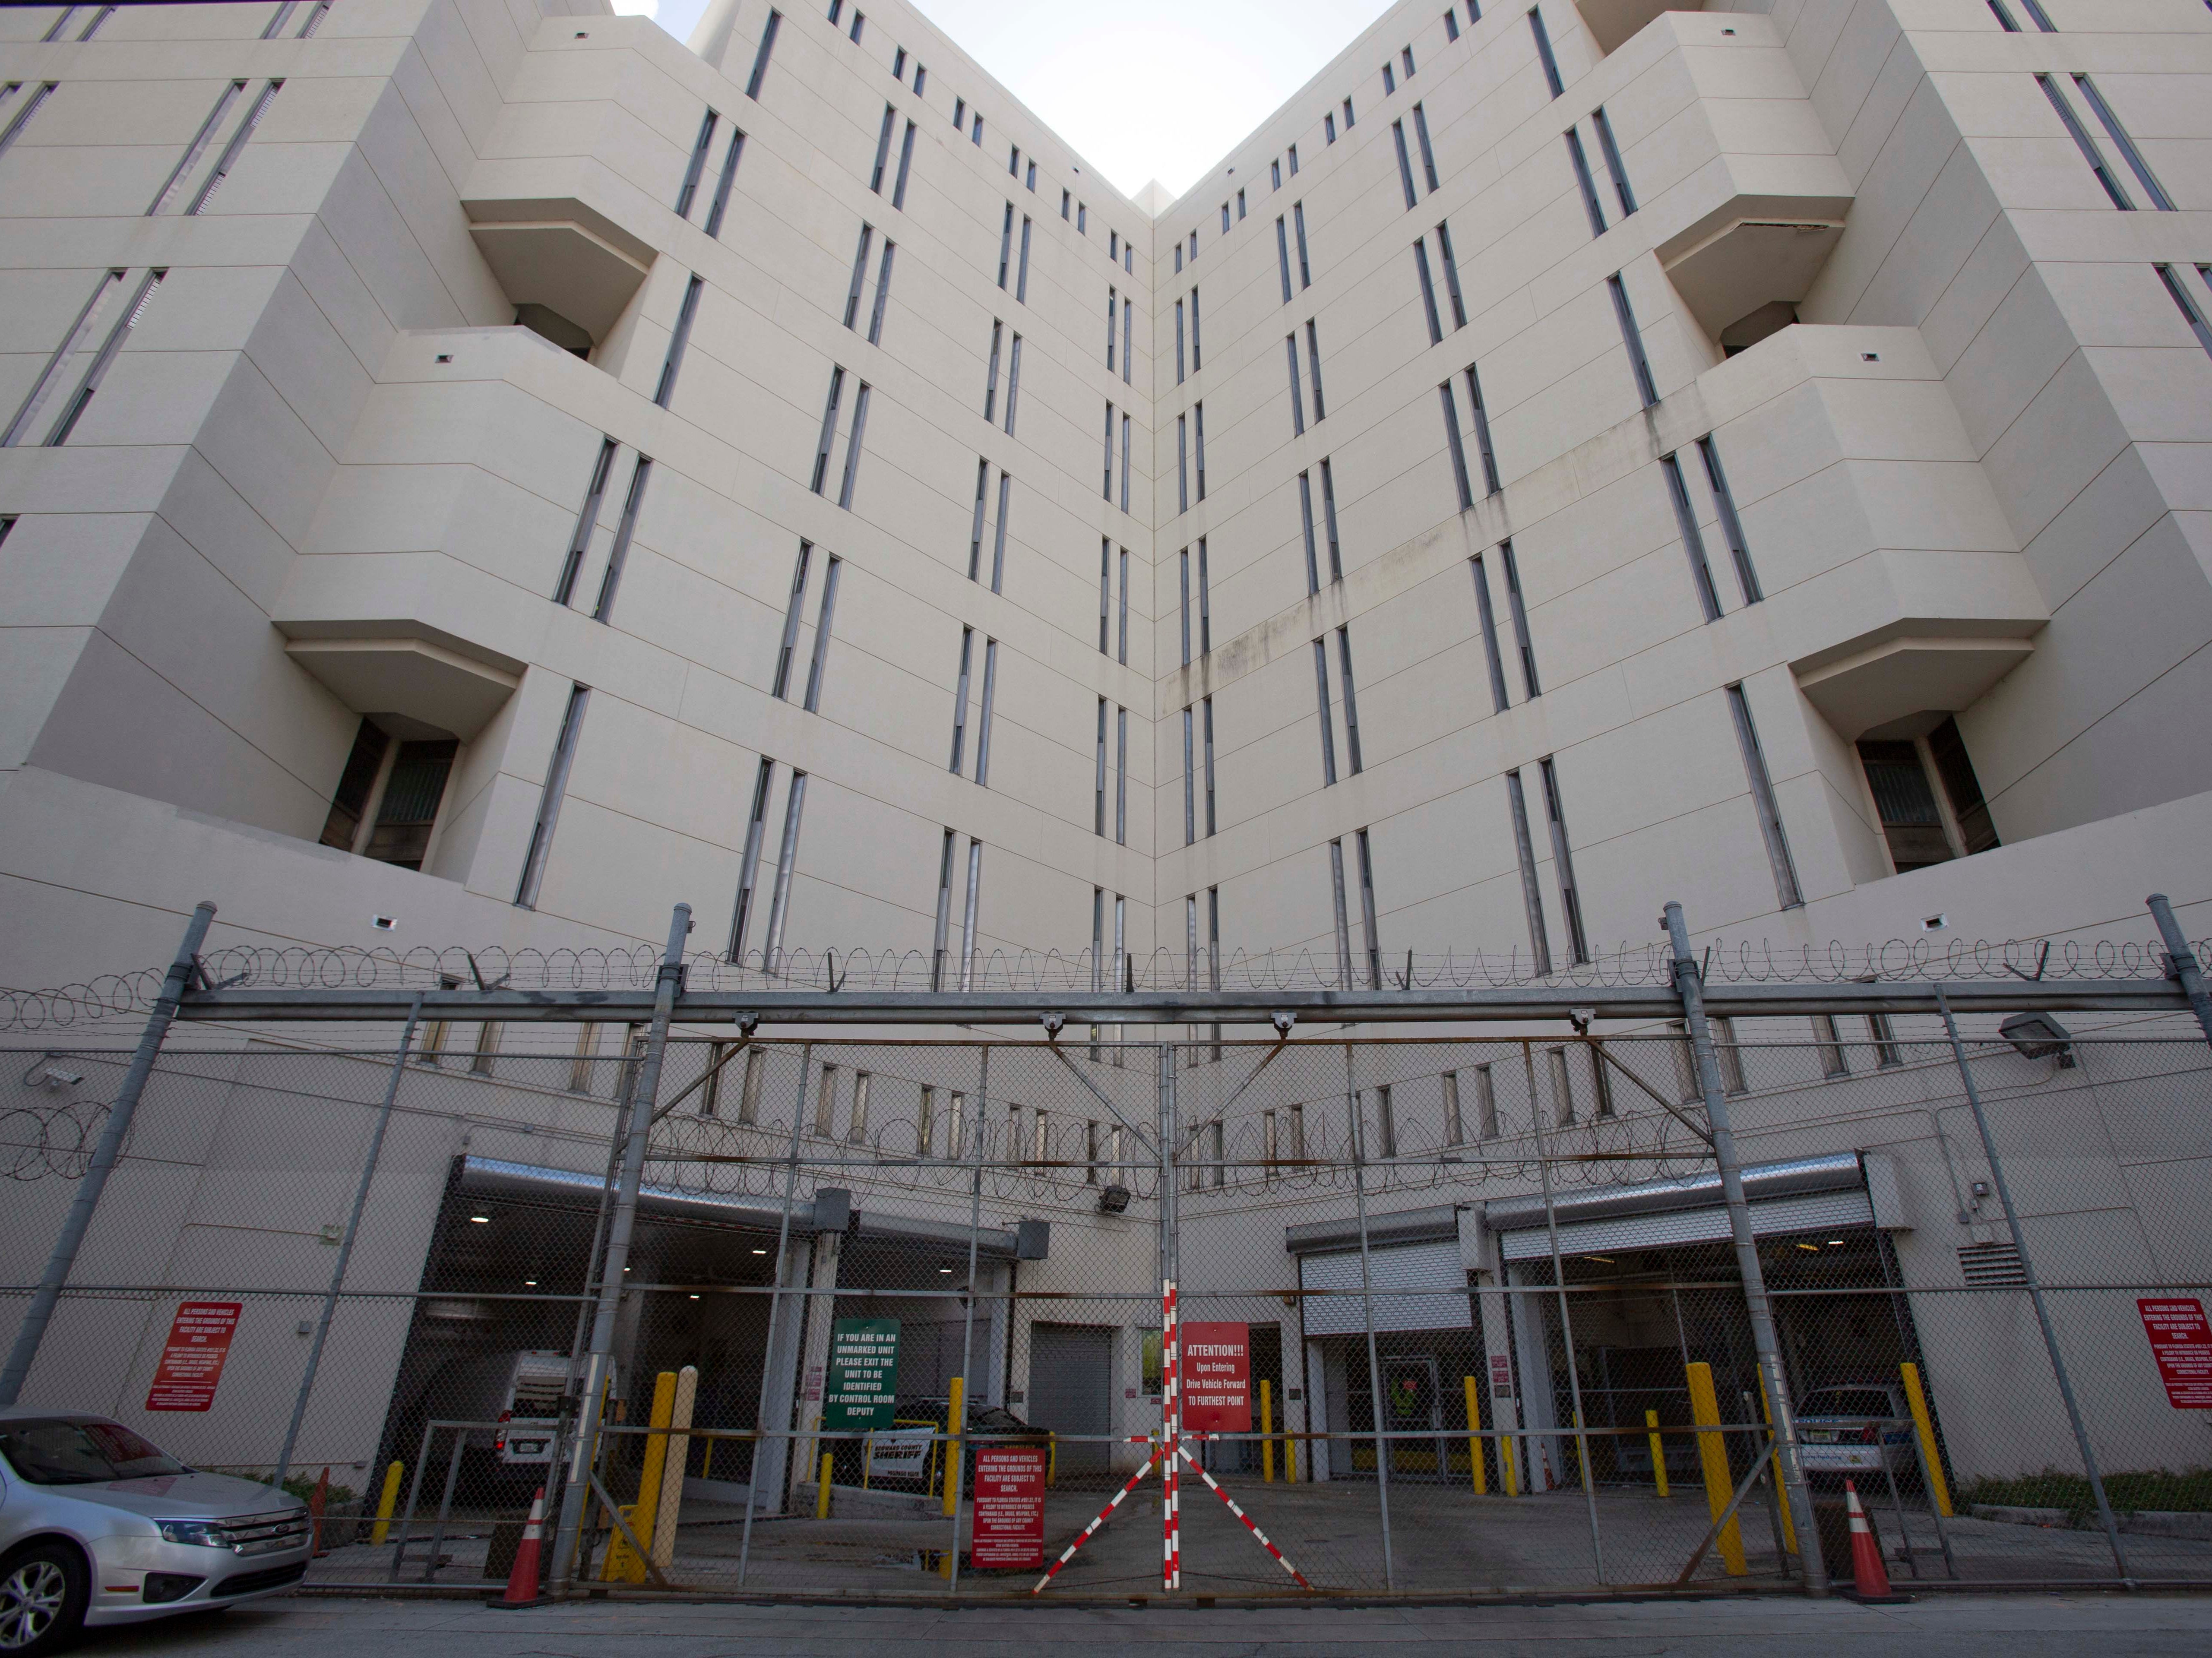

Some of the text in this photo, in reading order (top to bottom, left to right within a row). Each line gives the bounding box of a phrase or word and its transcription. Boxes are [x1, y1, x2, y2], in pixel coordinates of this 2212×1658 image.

[837, 1345, 895, 1354] UNMARKED UNIT
[1187, 1345, 1244, 1356] ATTENTION!!!
[836, 1358, 893, 1366] PLEASE EXIT THE
[1197, 1362, 1235, 1374] Upon Entering
[845, 1370, 883, 1378] UNIT TO BE
[843, 1382, 882, 1390] IDENTIFIED
[1187, 1379, 1246, 1389] Drive Vehicle Forward
[829, 1395, 839, 1403] BY
[839, 1395, 871, 1403] CONTROL
[873, 1395, 895, 1403] ROOM
[1188, 1396, 1244, 1406] TO FURTHEST POINT
[847, 1407, 874, 1416] DEPUTY
[873, 1451, 921, 1459] SHERIFF
